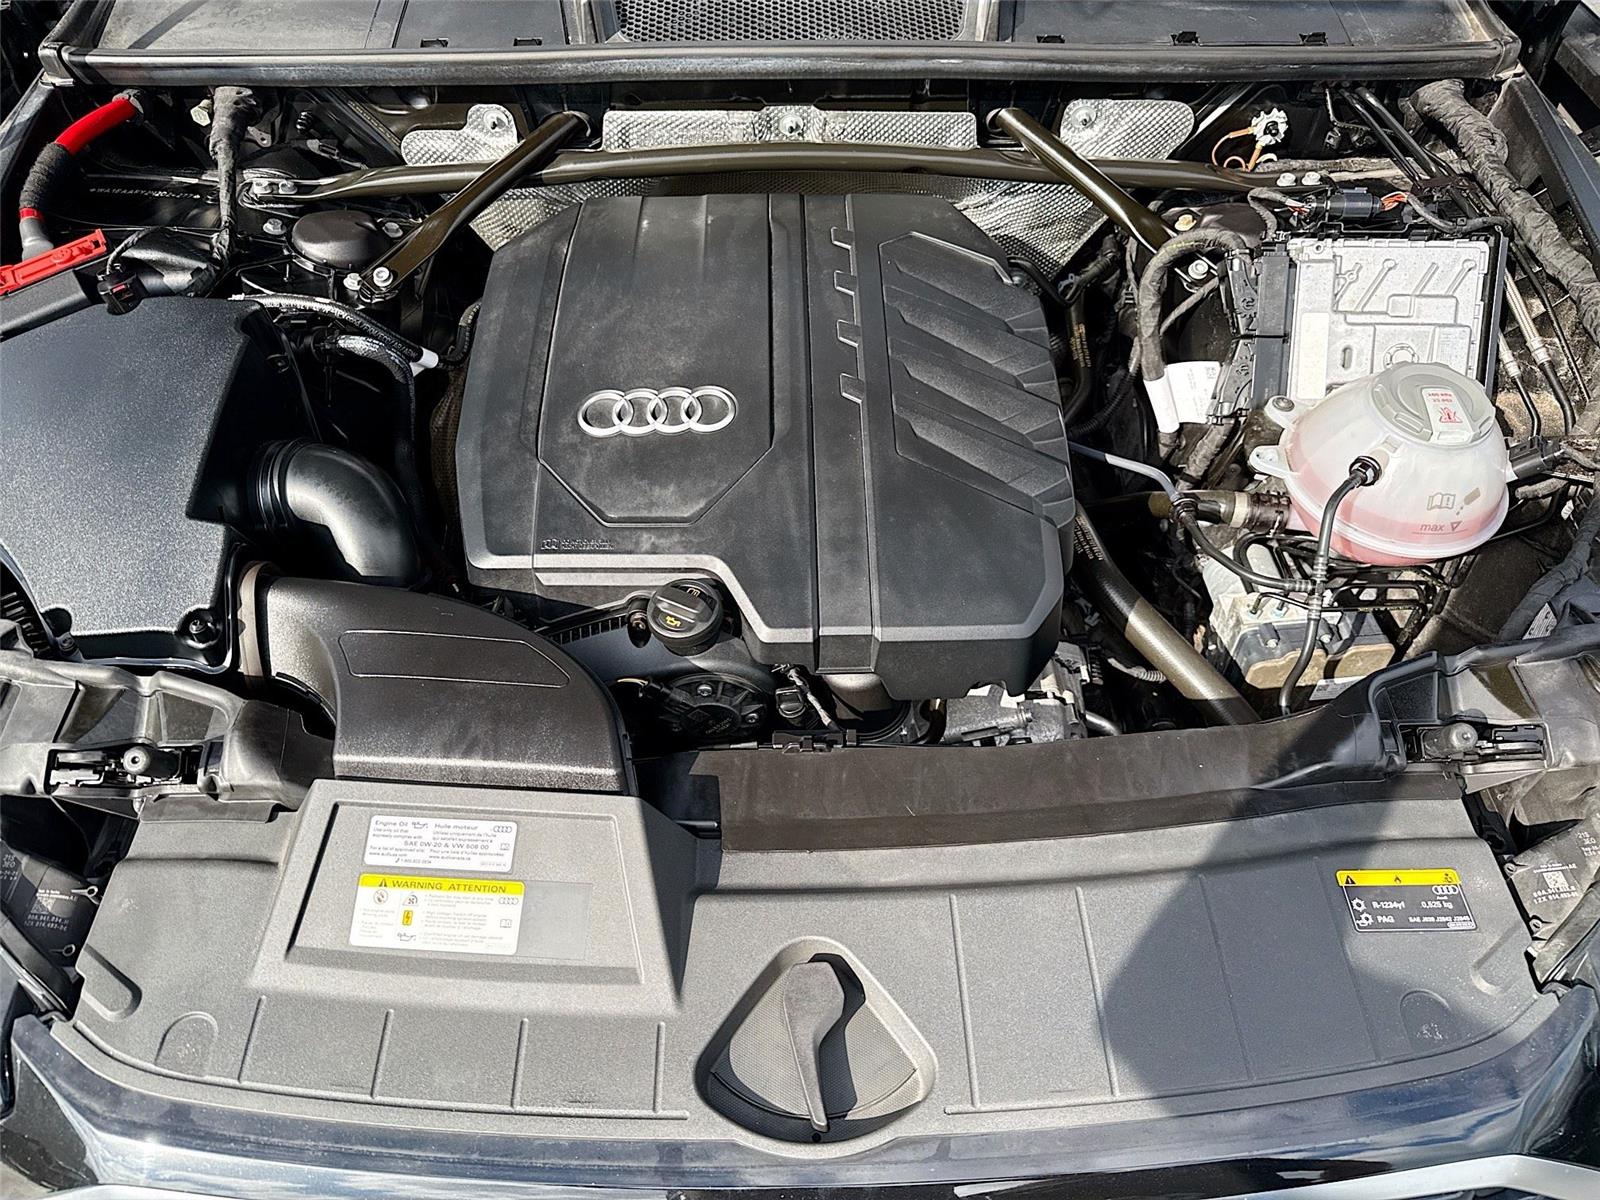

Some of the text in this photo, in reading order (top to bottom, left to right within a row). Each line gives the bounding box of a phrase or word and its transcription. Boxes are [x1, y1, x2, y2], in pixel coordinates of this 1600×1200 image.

[1420, 523, 1445, 532] max
[375, 820, 397, 828] Engine
[392, 880, 507, 893] WARNING ATTENTION
[1443, 902, 1453, 910] kg
[1377, 915, 1395, 923] PAG
